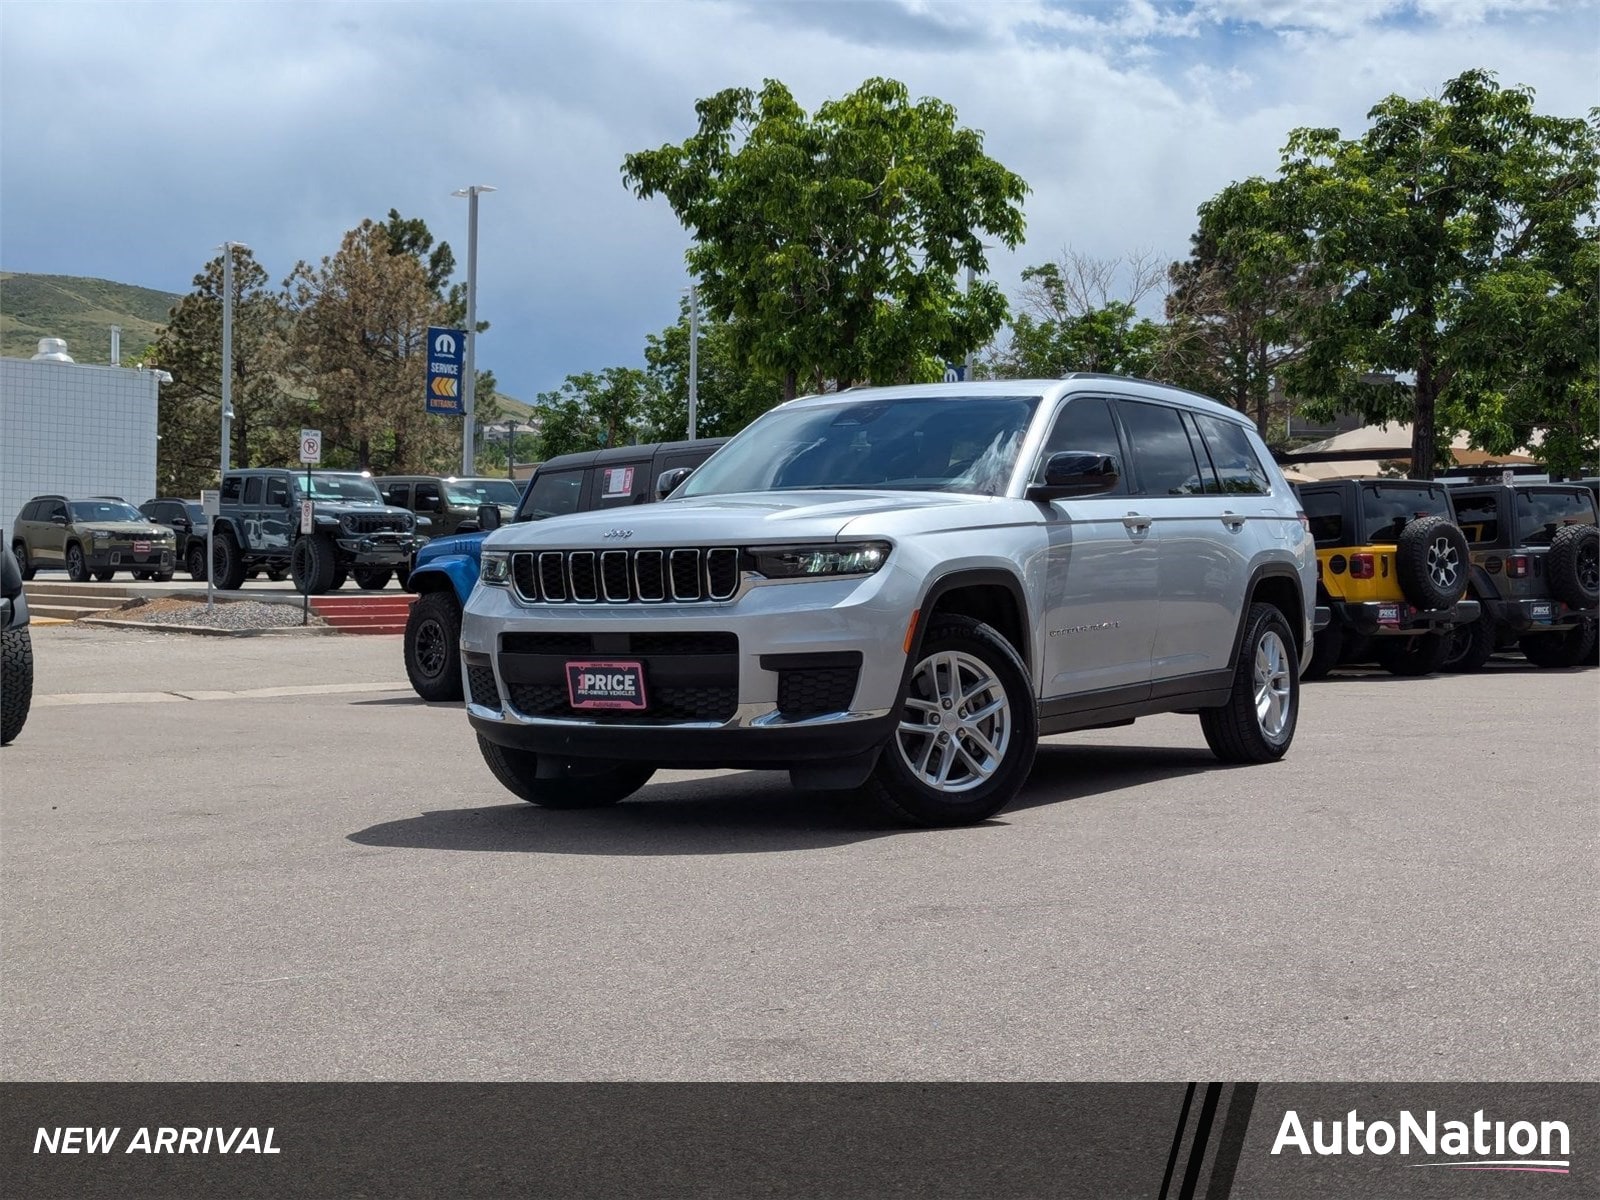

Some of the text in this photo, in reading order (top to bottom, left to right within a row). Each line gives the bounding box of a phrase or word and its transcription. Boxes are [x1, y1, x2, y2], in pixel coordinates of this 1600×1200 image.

[431, 362, 458, 375] SERVICE
[430, 399, 458, 409] ENTRANCE
[604, 528, 634, 539] Jeep
